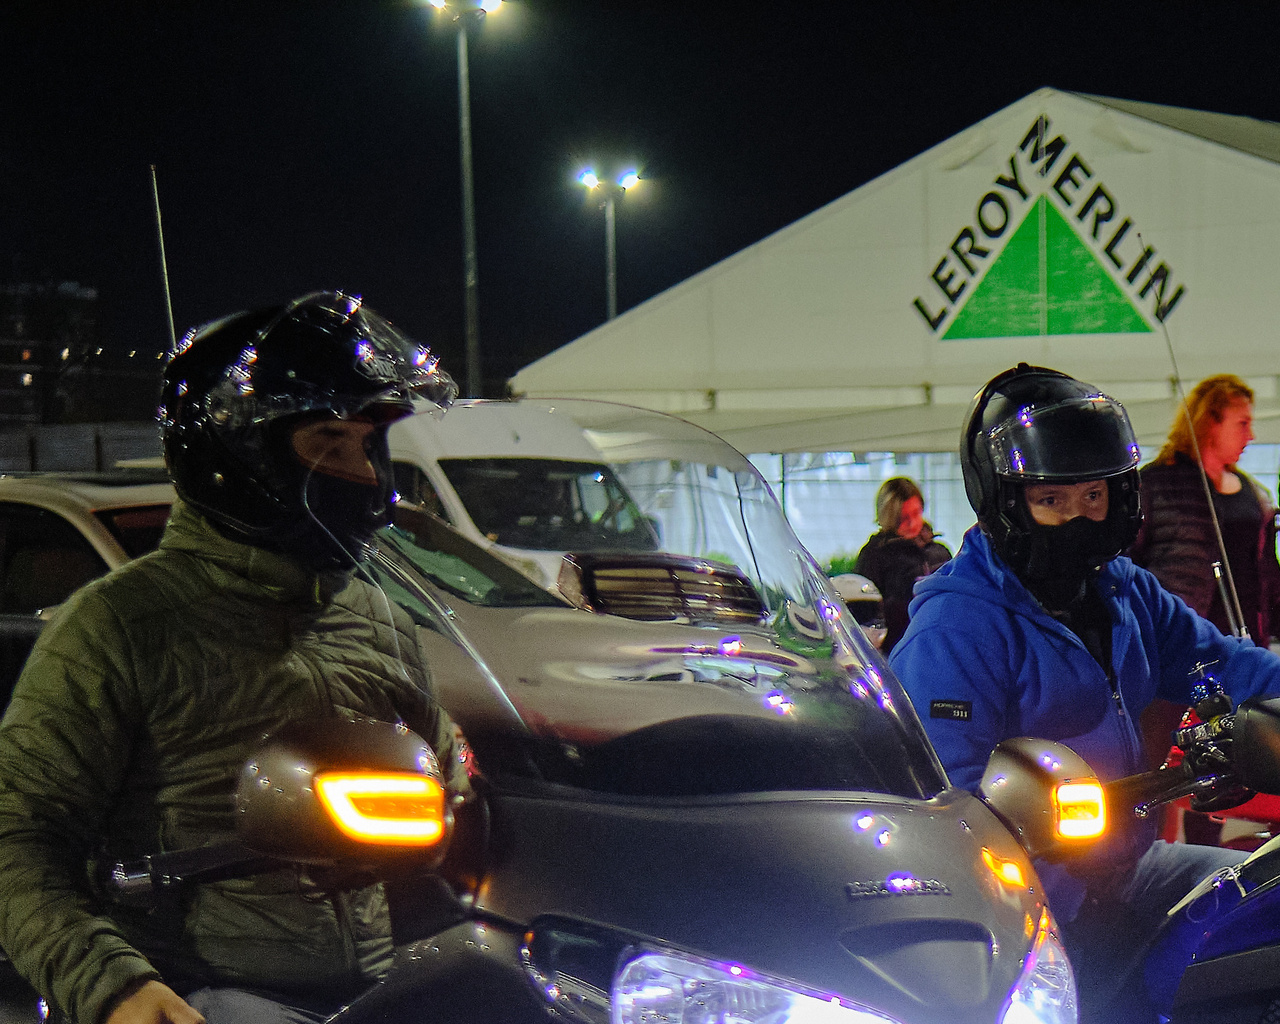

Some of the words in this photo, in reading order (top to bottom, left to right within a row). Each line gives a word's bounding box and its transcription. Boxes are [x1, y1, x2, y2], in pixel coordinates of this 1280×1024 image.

[912, 155, 1031, 331] LEROY
[1018, 113, 1186, 323] MERLIN
[953, 710, 968, 718] 911
